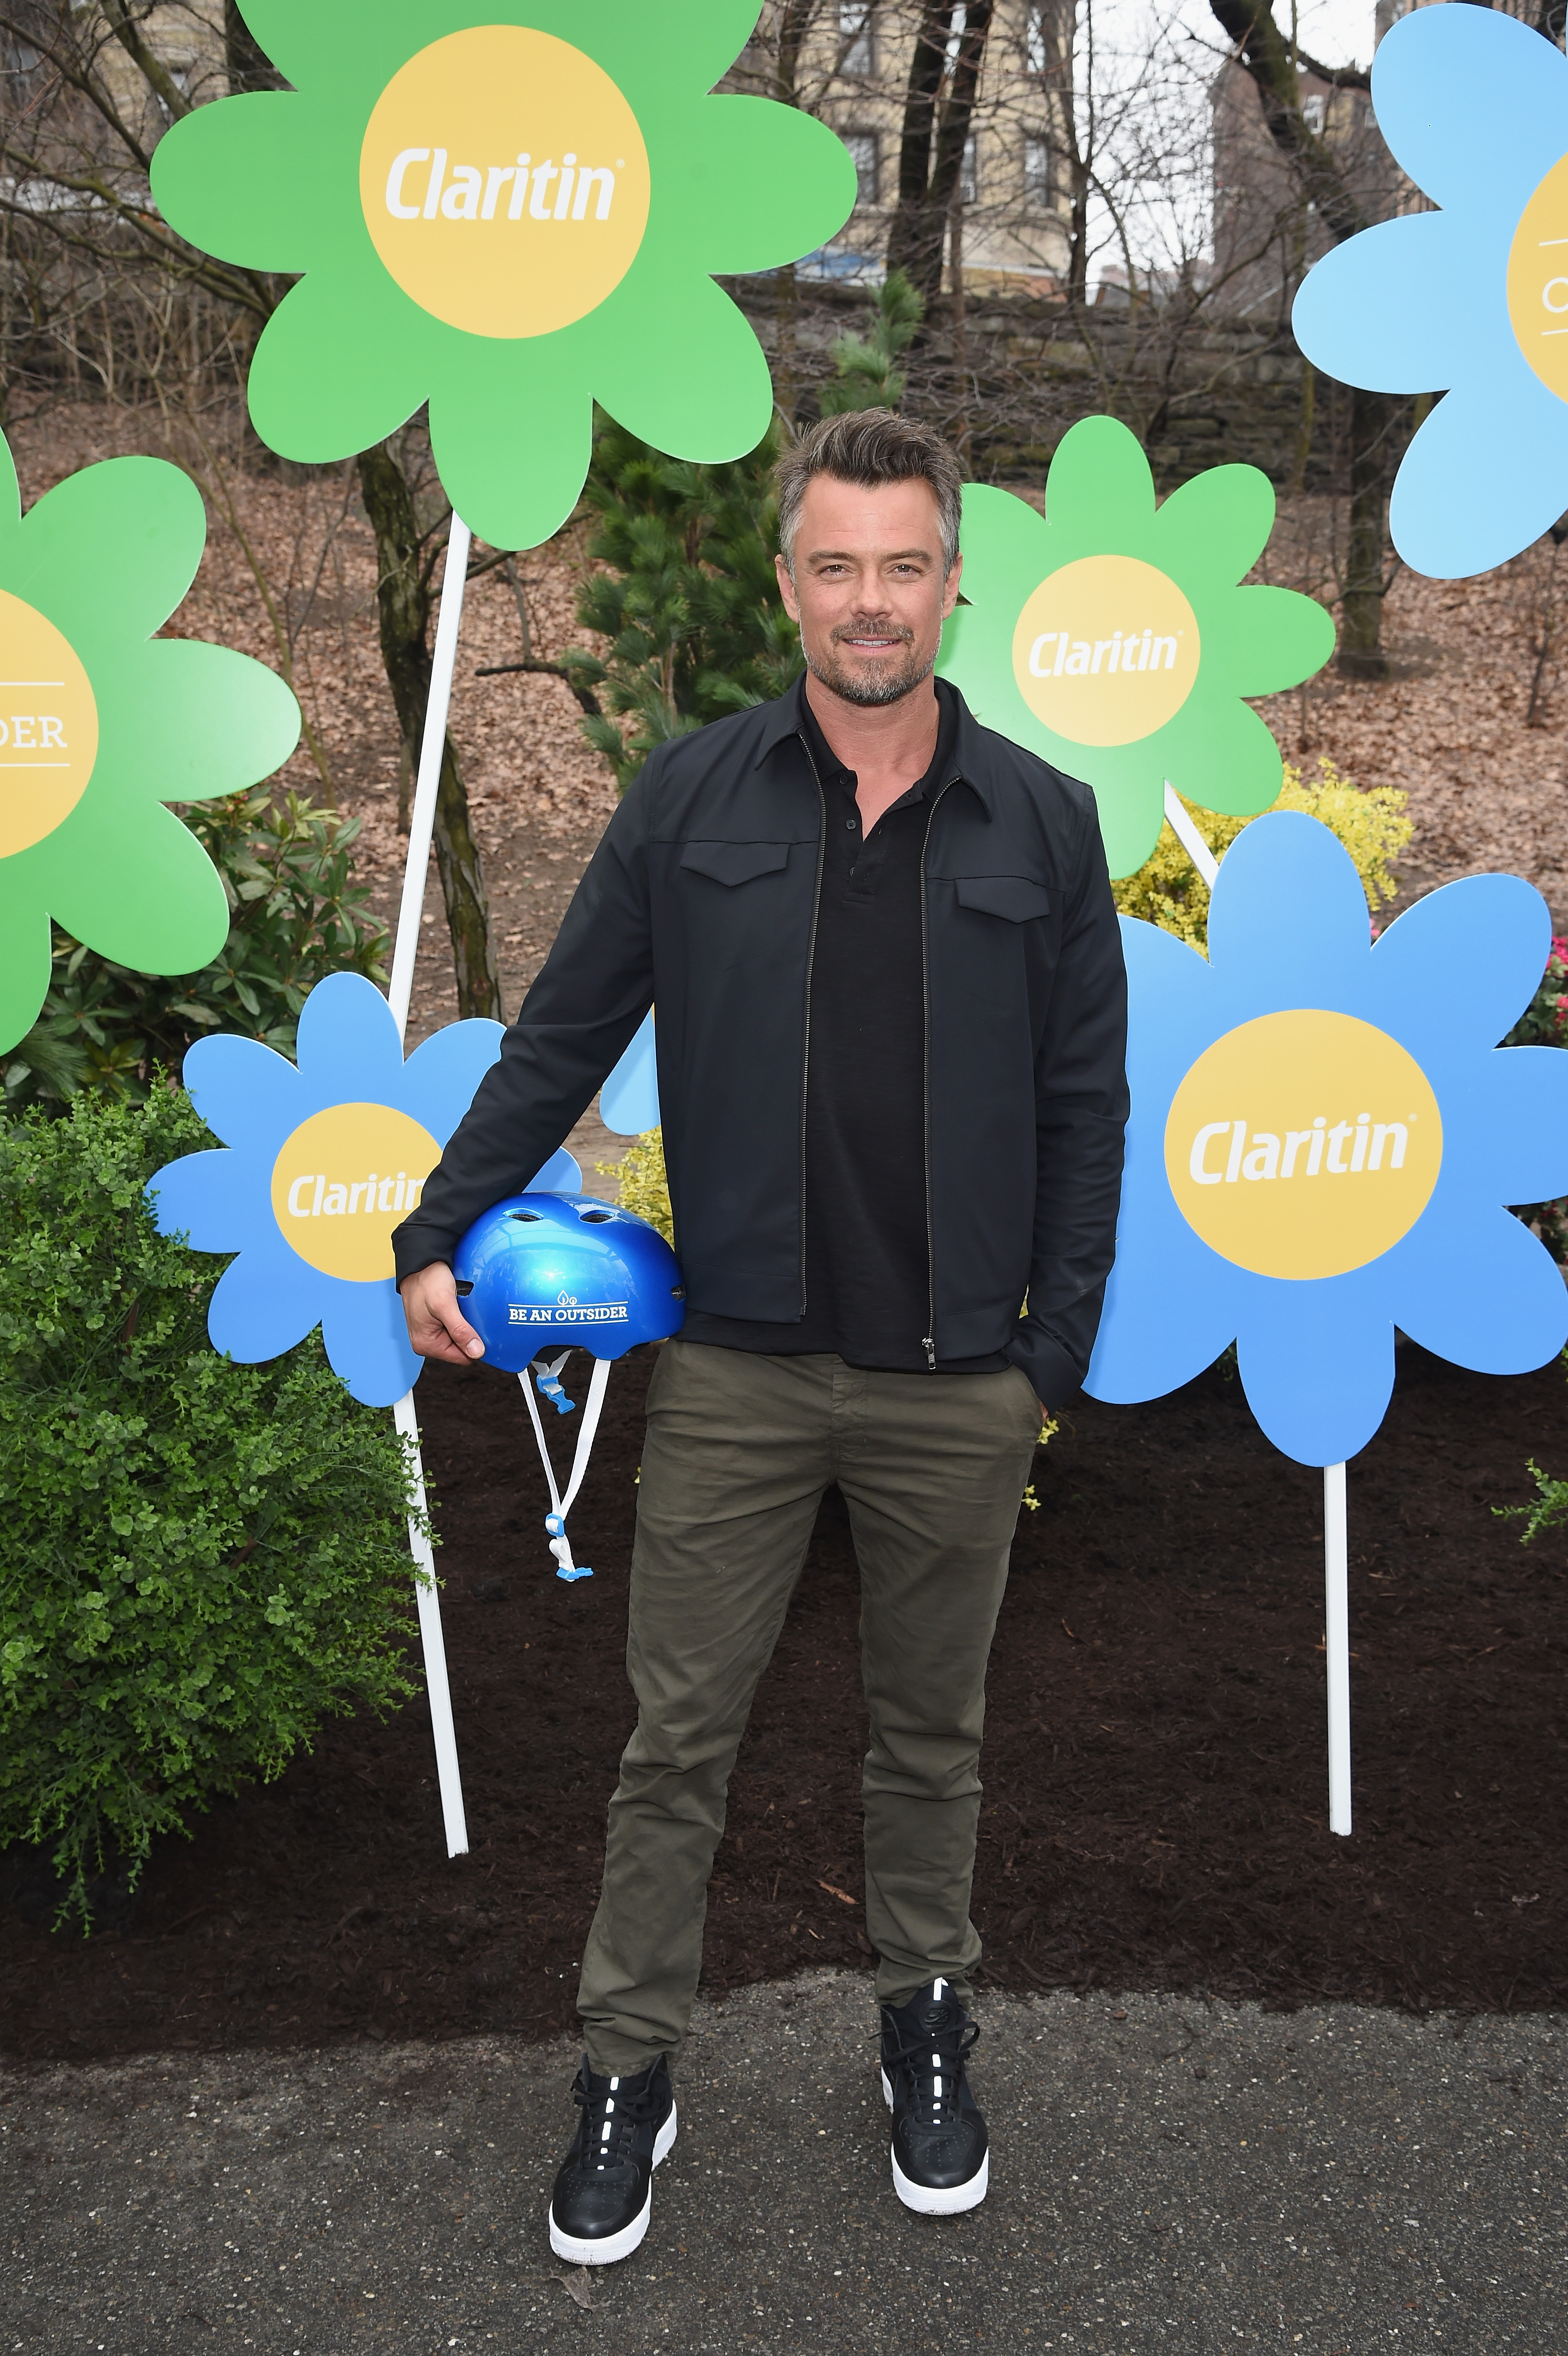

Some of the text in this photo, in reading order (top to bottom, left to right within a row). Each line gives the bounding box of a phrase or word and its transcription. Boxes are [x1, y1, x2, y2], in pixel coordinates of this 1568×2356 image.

[509, 1306, 628, 1321] BE AN OUTSIDER
